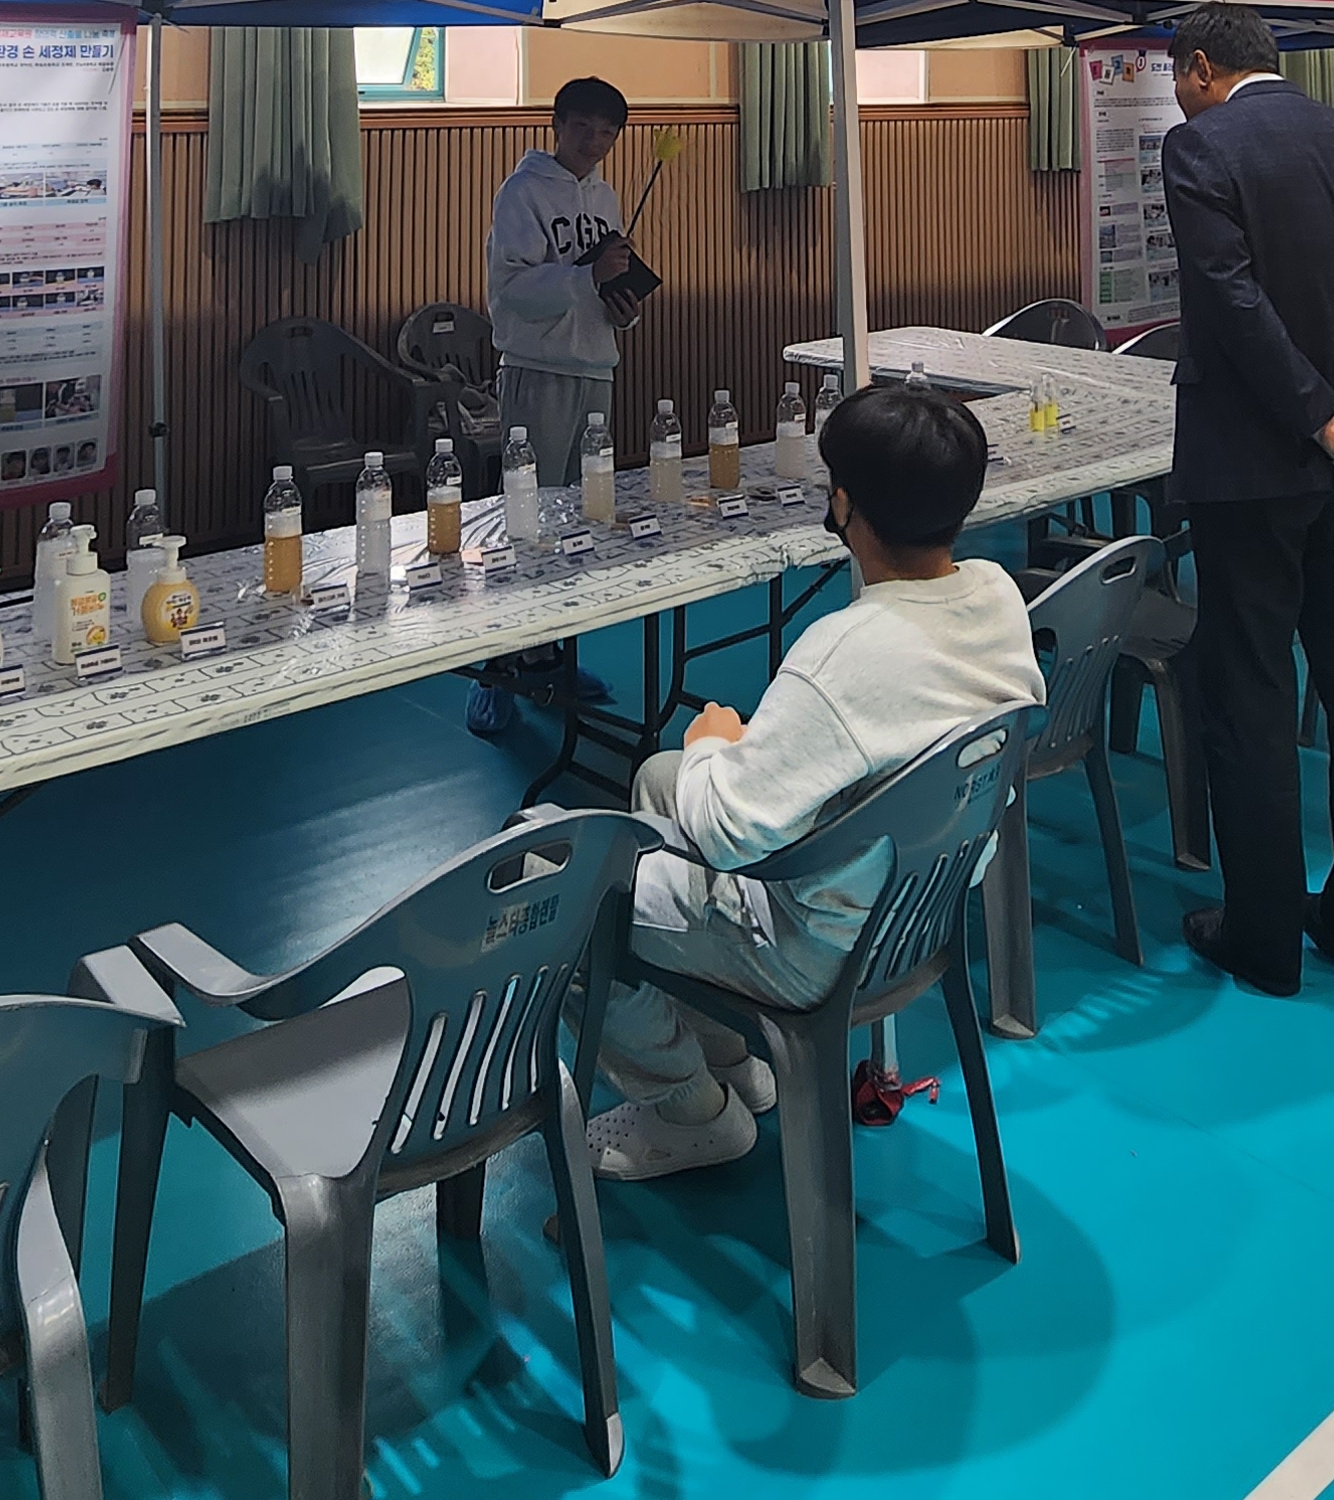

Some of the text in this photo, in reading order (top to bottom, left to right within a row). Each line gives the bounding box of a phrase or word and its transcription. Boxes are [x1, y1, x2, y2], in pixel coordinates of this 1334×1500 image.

[22, 45, 35, 59] 손
[38, 44, 77, 59] 세정제
[79, 44, 114, 58] 만들기
